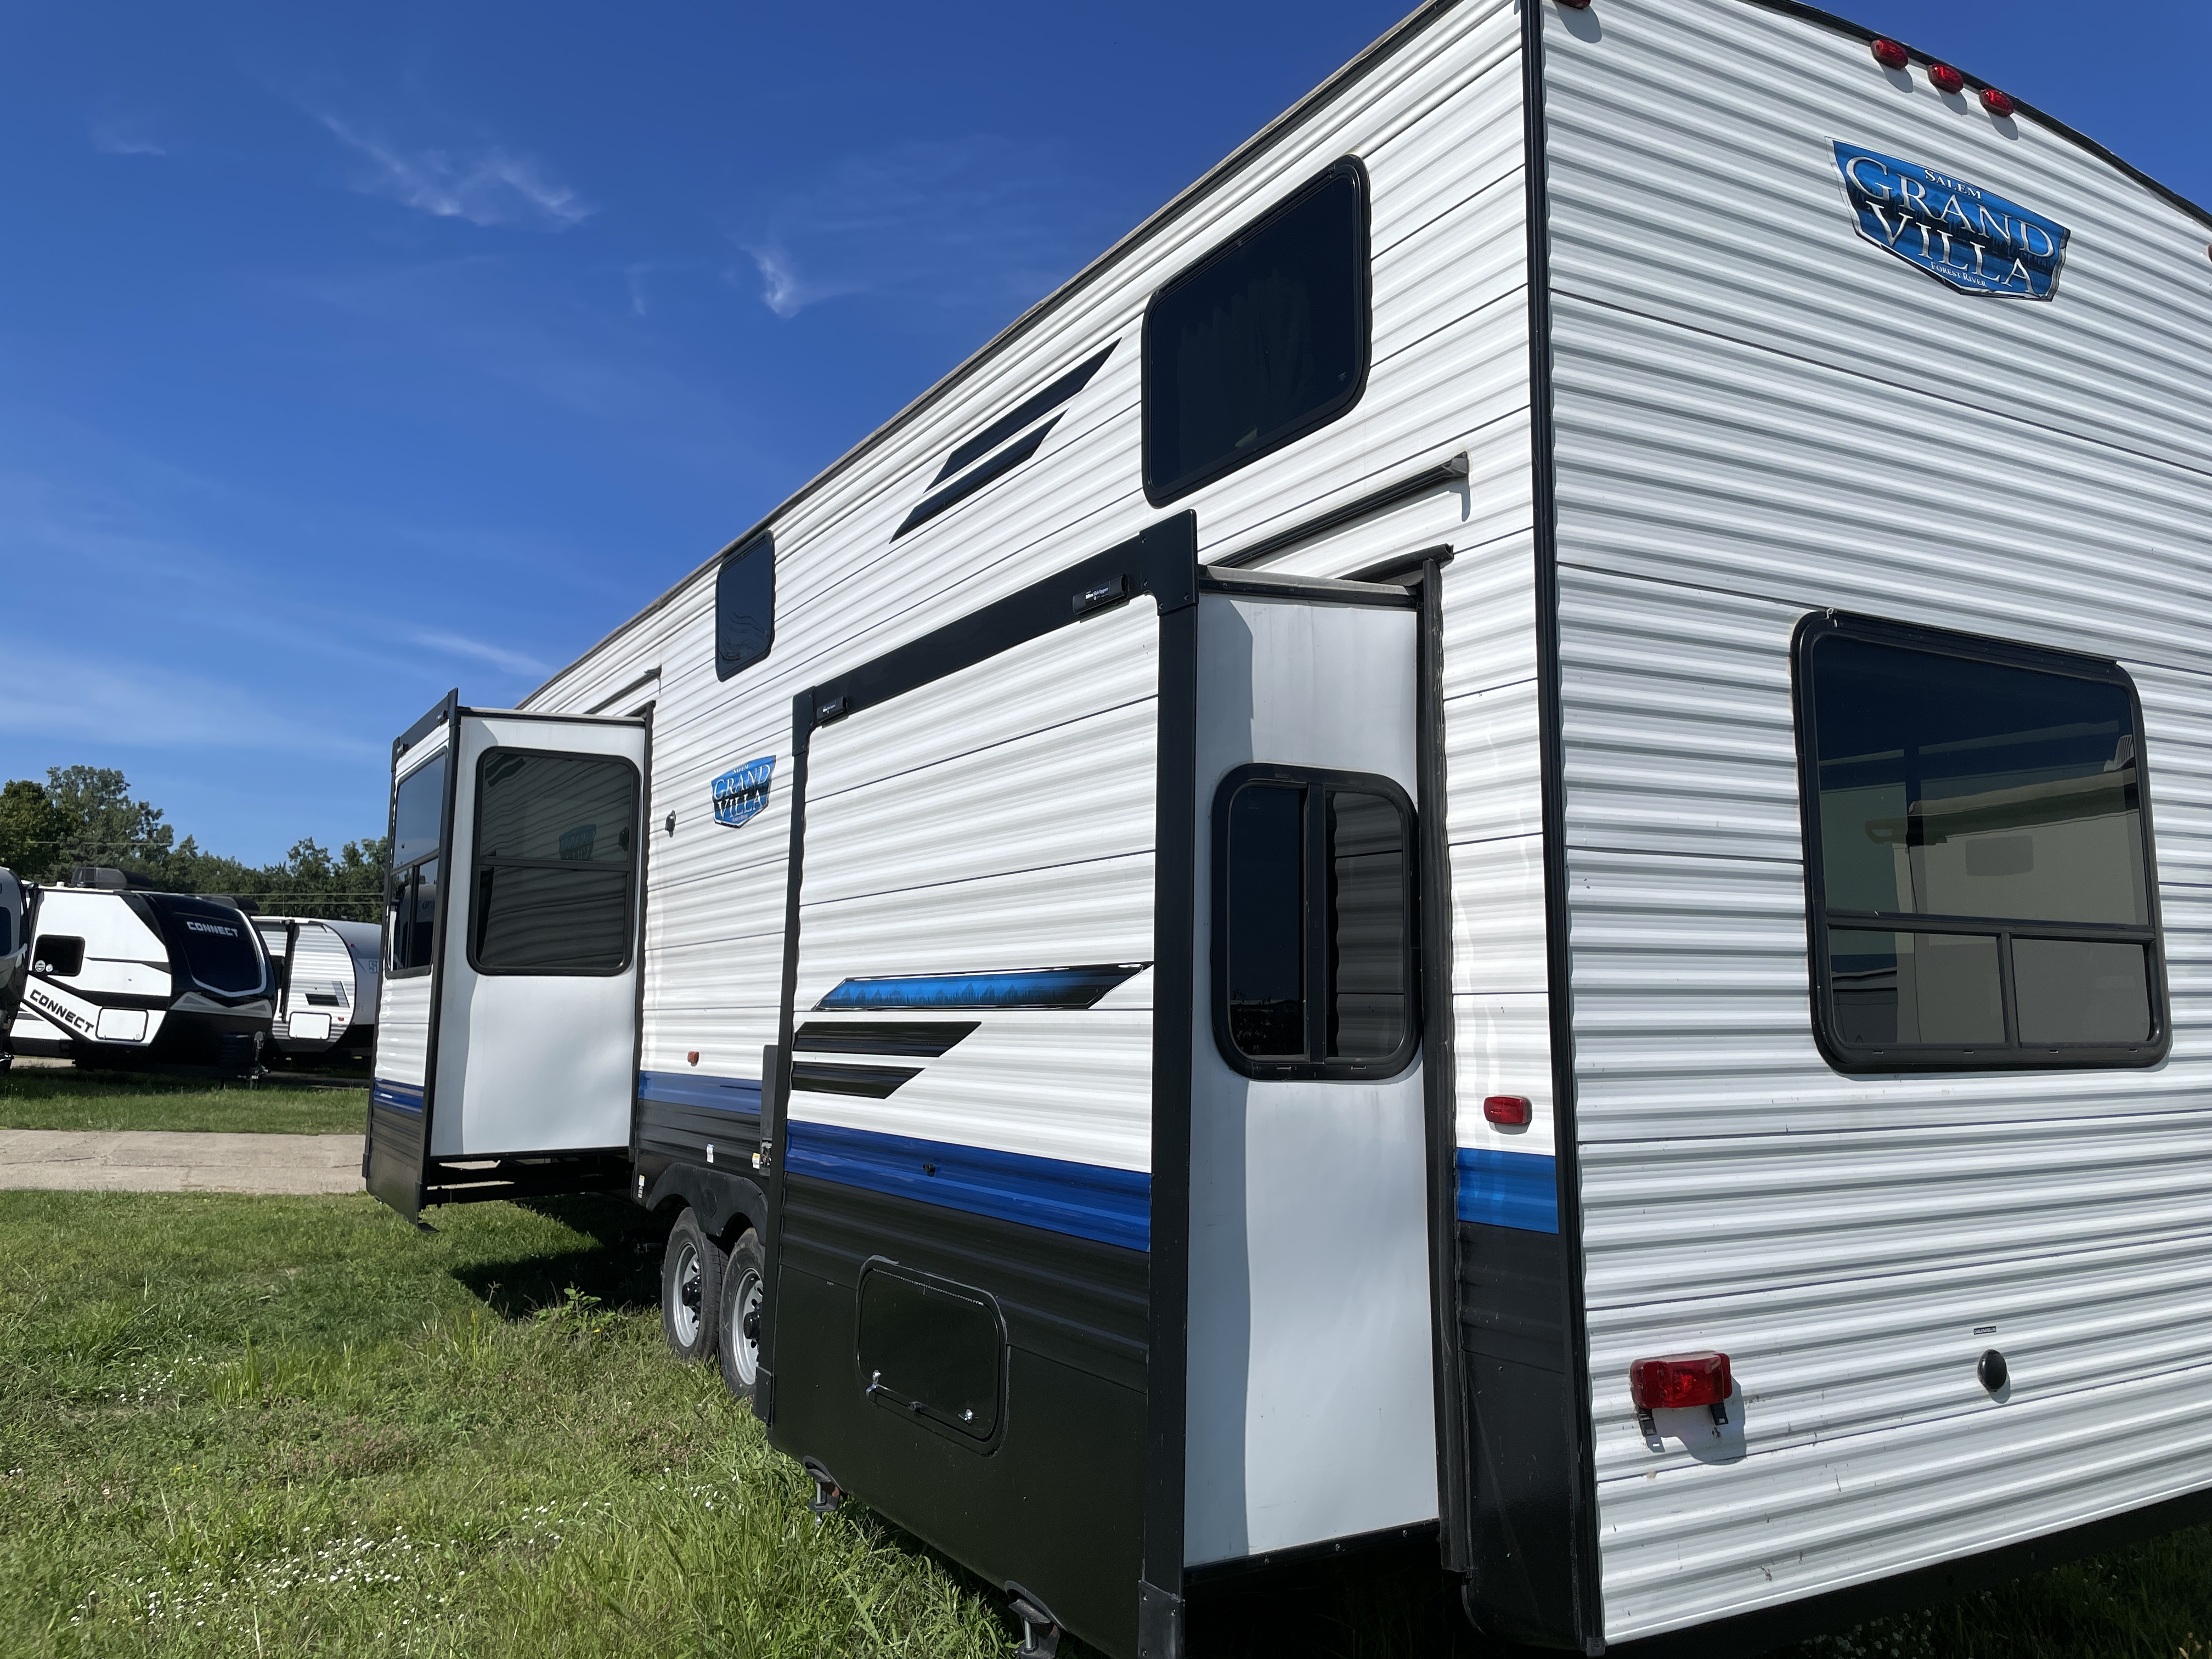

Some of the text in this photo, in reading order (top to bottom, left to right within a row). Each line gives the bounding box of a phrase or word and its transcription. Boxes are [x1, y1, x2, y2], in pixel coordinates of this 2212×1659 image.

[1925, 169, 1983, 201] SALEM
[1845, 156, 2054, 258] GRAND
[1865, 200, 2040, 299] VILLA
[1931, 261, 1988, 287] FOREST RIVER
[713, 764, 771, 800] GRAND
[717, 789, 764, 820] VILLA
[186, 921, 239, 938] CONNECT
[30, 989, 94, 1033] CONNECT
